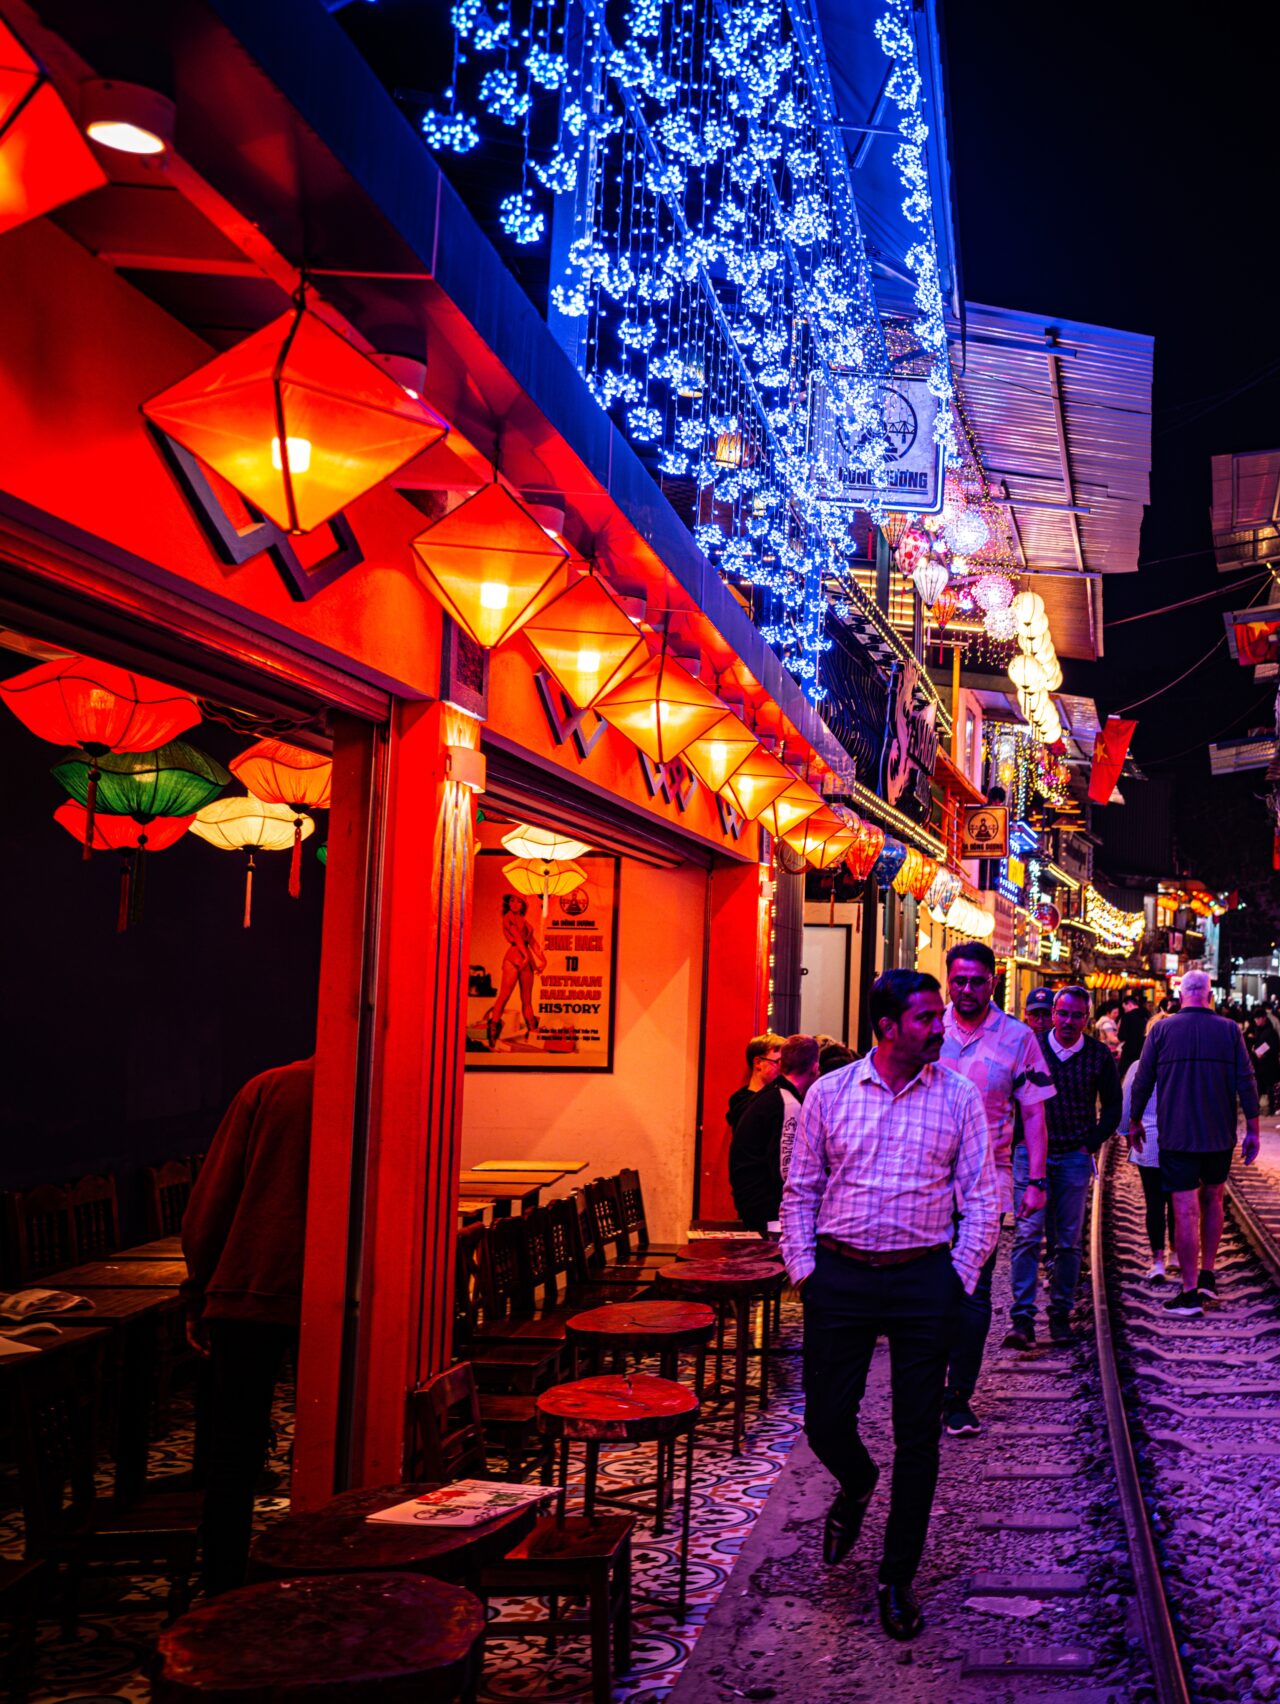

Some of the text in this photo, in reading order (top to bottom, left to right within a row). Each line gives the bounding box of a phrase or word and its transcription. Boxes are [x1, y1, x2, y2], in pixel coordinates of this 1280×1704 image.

[575, 935, 603, 951] BACK
[565, 956, 578, 972] TO
[541, 975, 602, 987] VIETNAM
[540, 989, 601, 1000] RAILROAD
[539, 1003, 601, 1014] HISTORY
